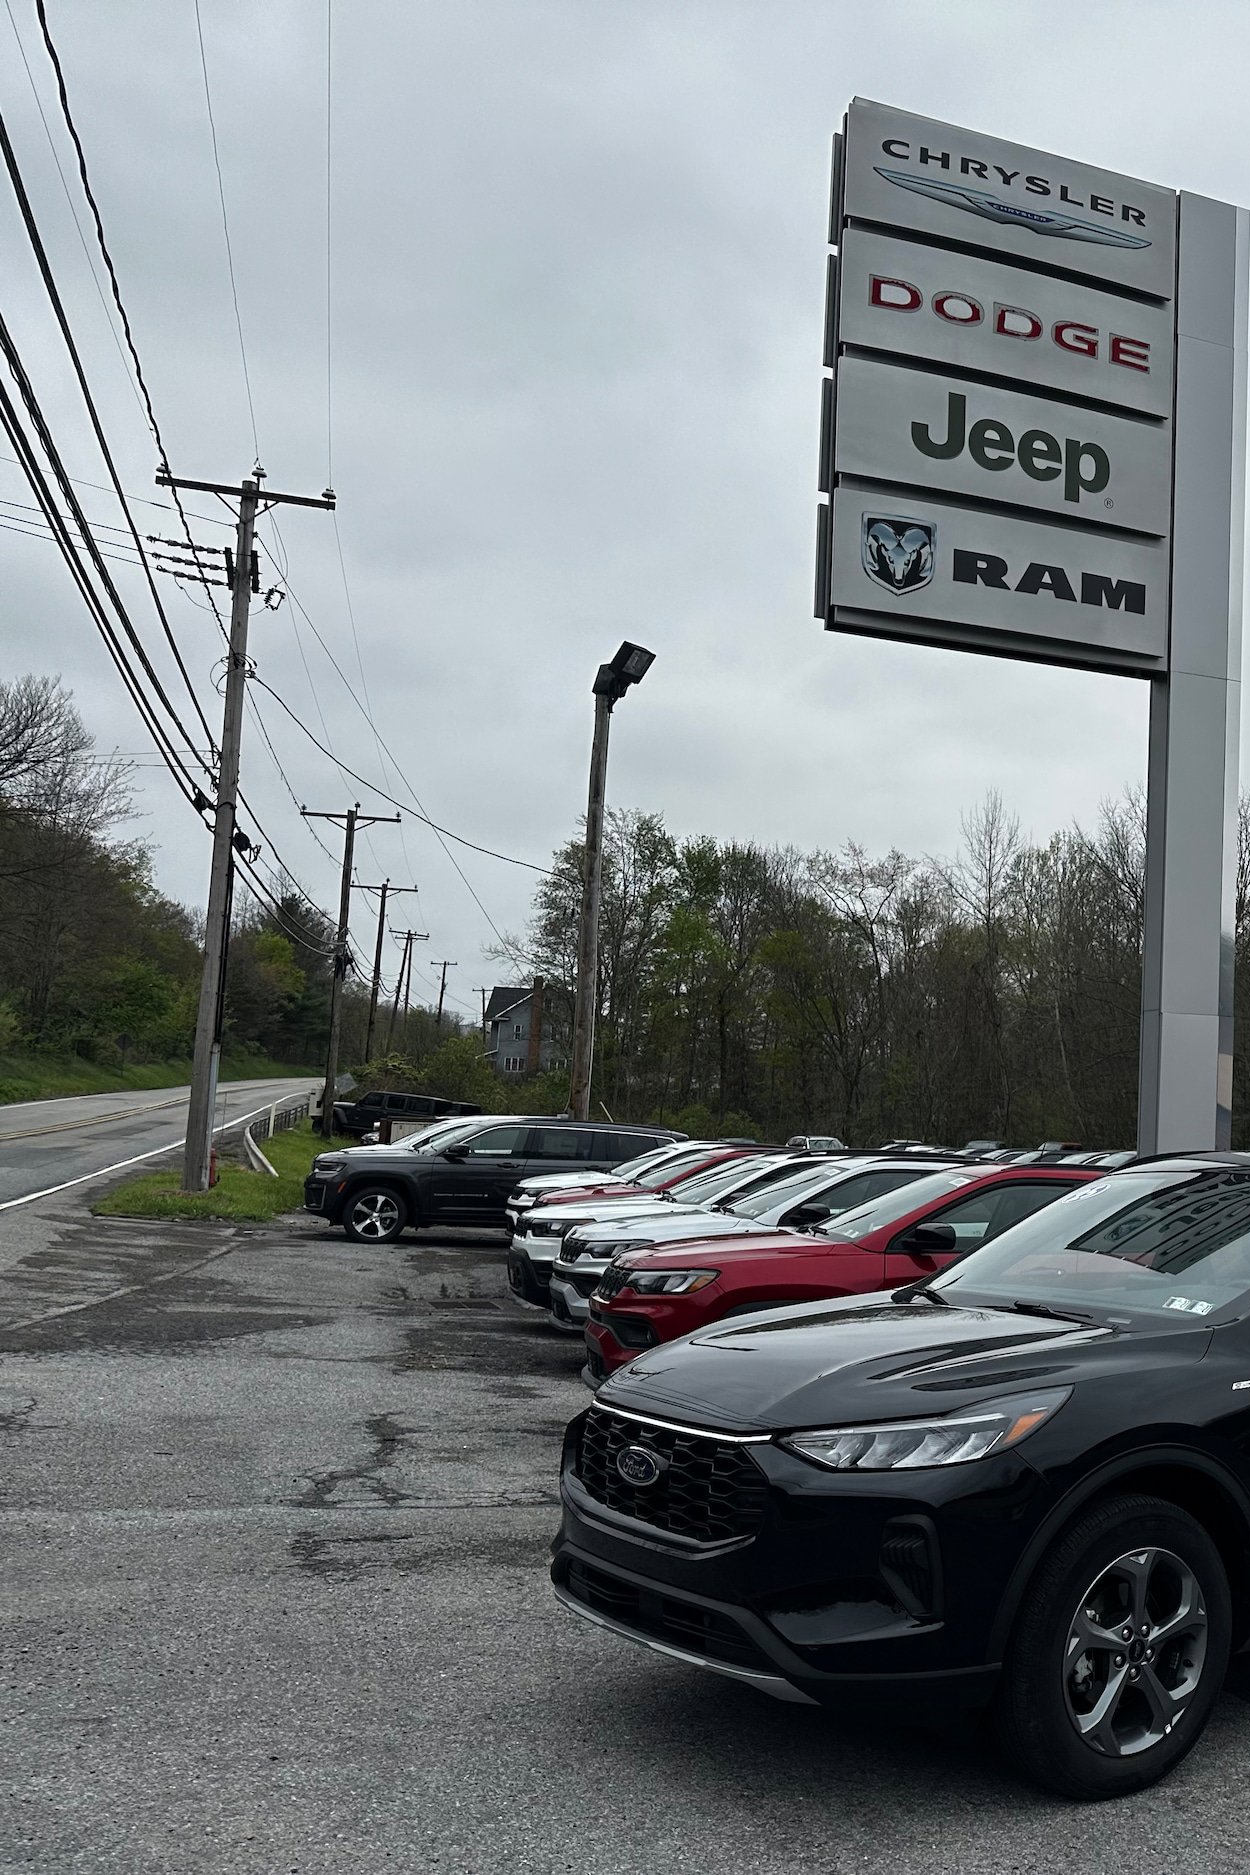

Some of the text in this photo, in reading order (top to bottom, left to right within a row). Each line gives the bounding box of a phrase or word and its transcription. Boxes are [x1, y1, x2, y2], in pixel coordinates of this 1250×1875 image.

[882, 139, 1147, 228] CHRYSLER
[993, 204, 1047, 223] CHRYSLER
[869, 273, 1150, 374] DODGE
[911, 392, 1110, 503] Jeep
[953, 548, 1146, 616] RAM
[622, 1453, 648, 1478] Ford
